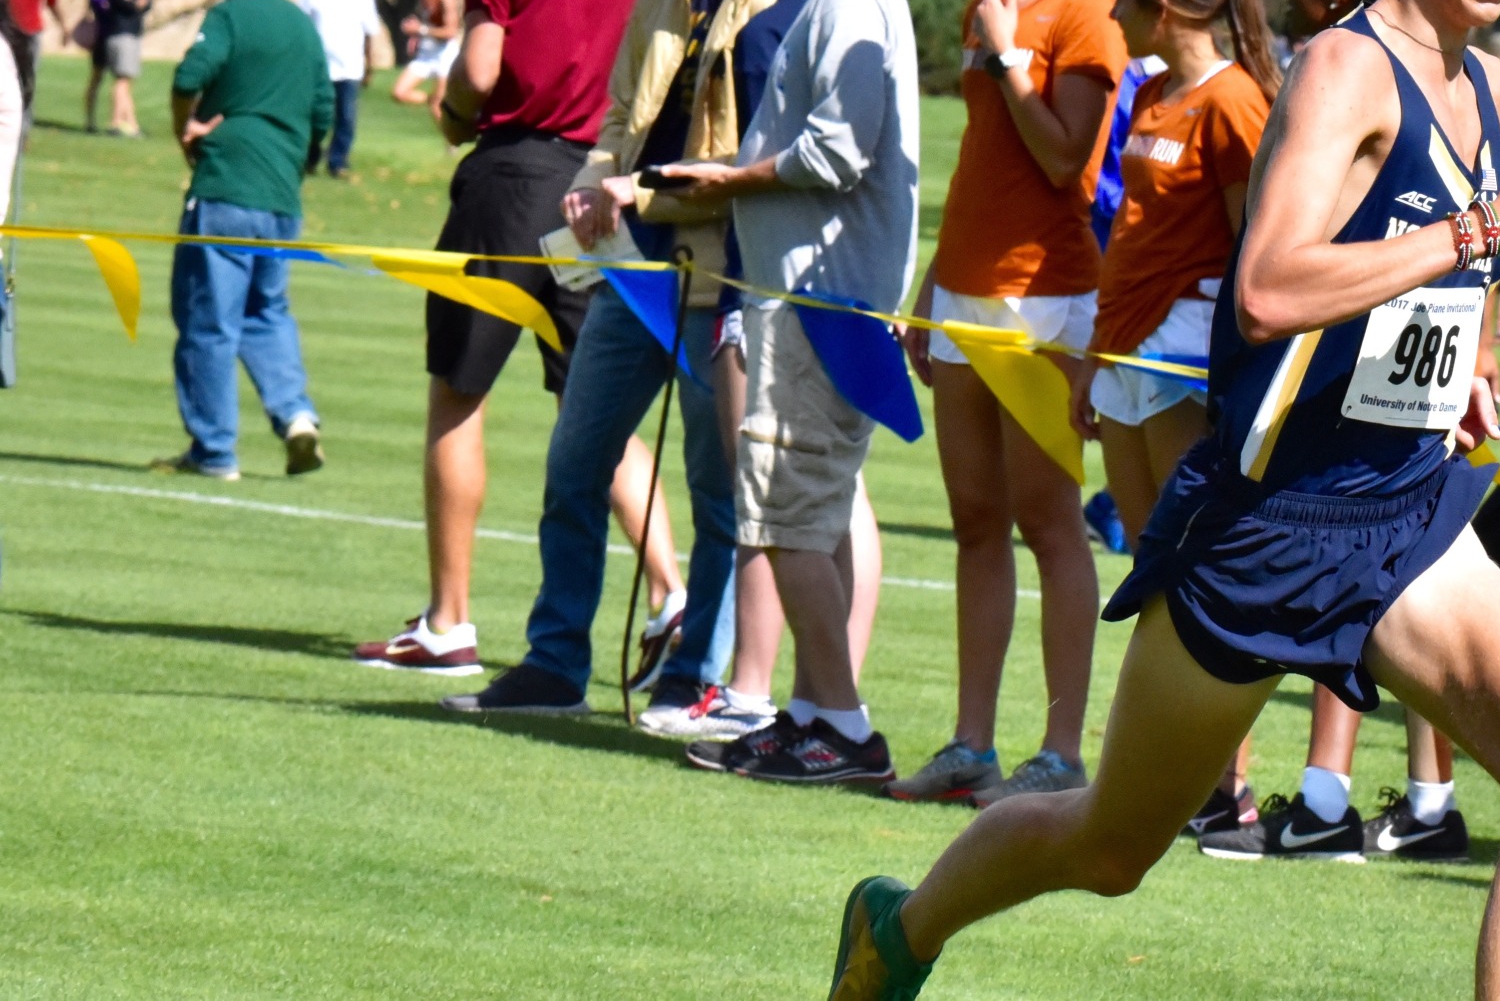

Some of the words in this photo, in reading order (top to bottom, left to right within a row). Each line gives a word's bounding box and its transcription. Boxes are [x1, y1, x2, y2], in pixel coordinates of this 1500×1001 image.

[1148, 137, 1185, 165] RUN
[1396, 190, 1437, 211] ACC
[1411, 301, 1426, 313] Joe
[1427, 303, 1446, 313] Piane
[1446, 302, 1477, 313] Invitational
[1388, 324, 1460, 388] 986
[1360, 393, 1406, 412] University
[1407, 400, 1417, 411] of
[1417, 400, 1437, 412] Notre
[1438, 401, 1458, 412] Dame
